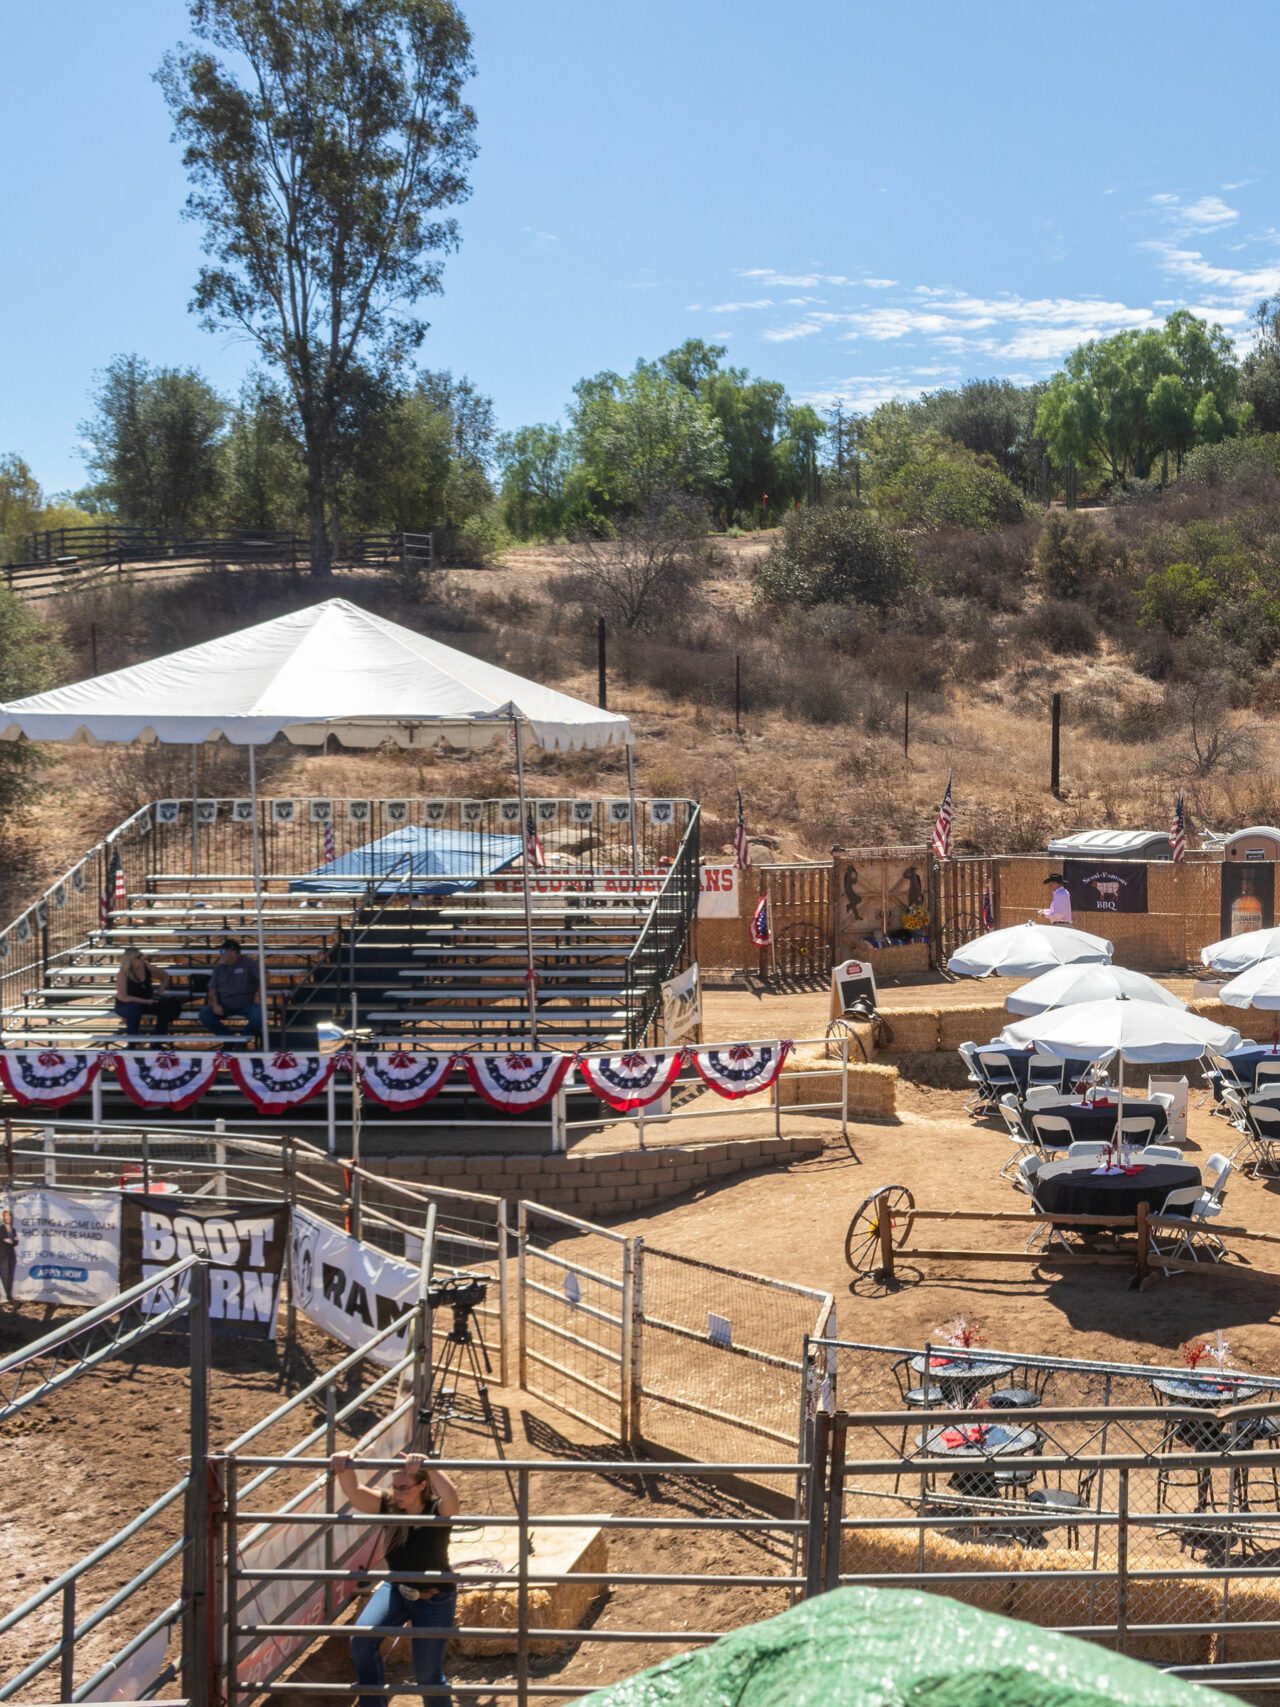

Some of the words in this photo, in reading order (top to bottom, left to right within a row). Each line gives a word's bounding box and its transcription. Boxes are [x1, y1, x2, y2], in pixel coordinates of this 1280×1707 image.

[1096, 900, 1118, 911] BBQ
[64, 1220, 90, 1230] HOME
[79, 1231, 103, 1241] HARD
[140, 1211, 275, 1267] BOOT
